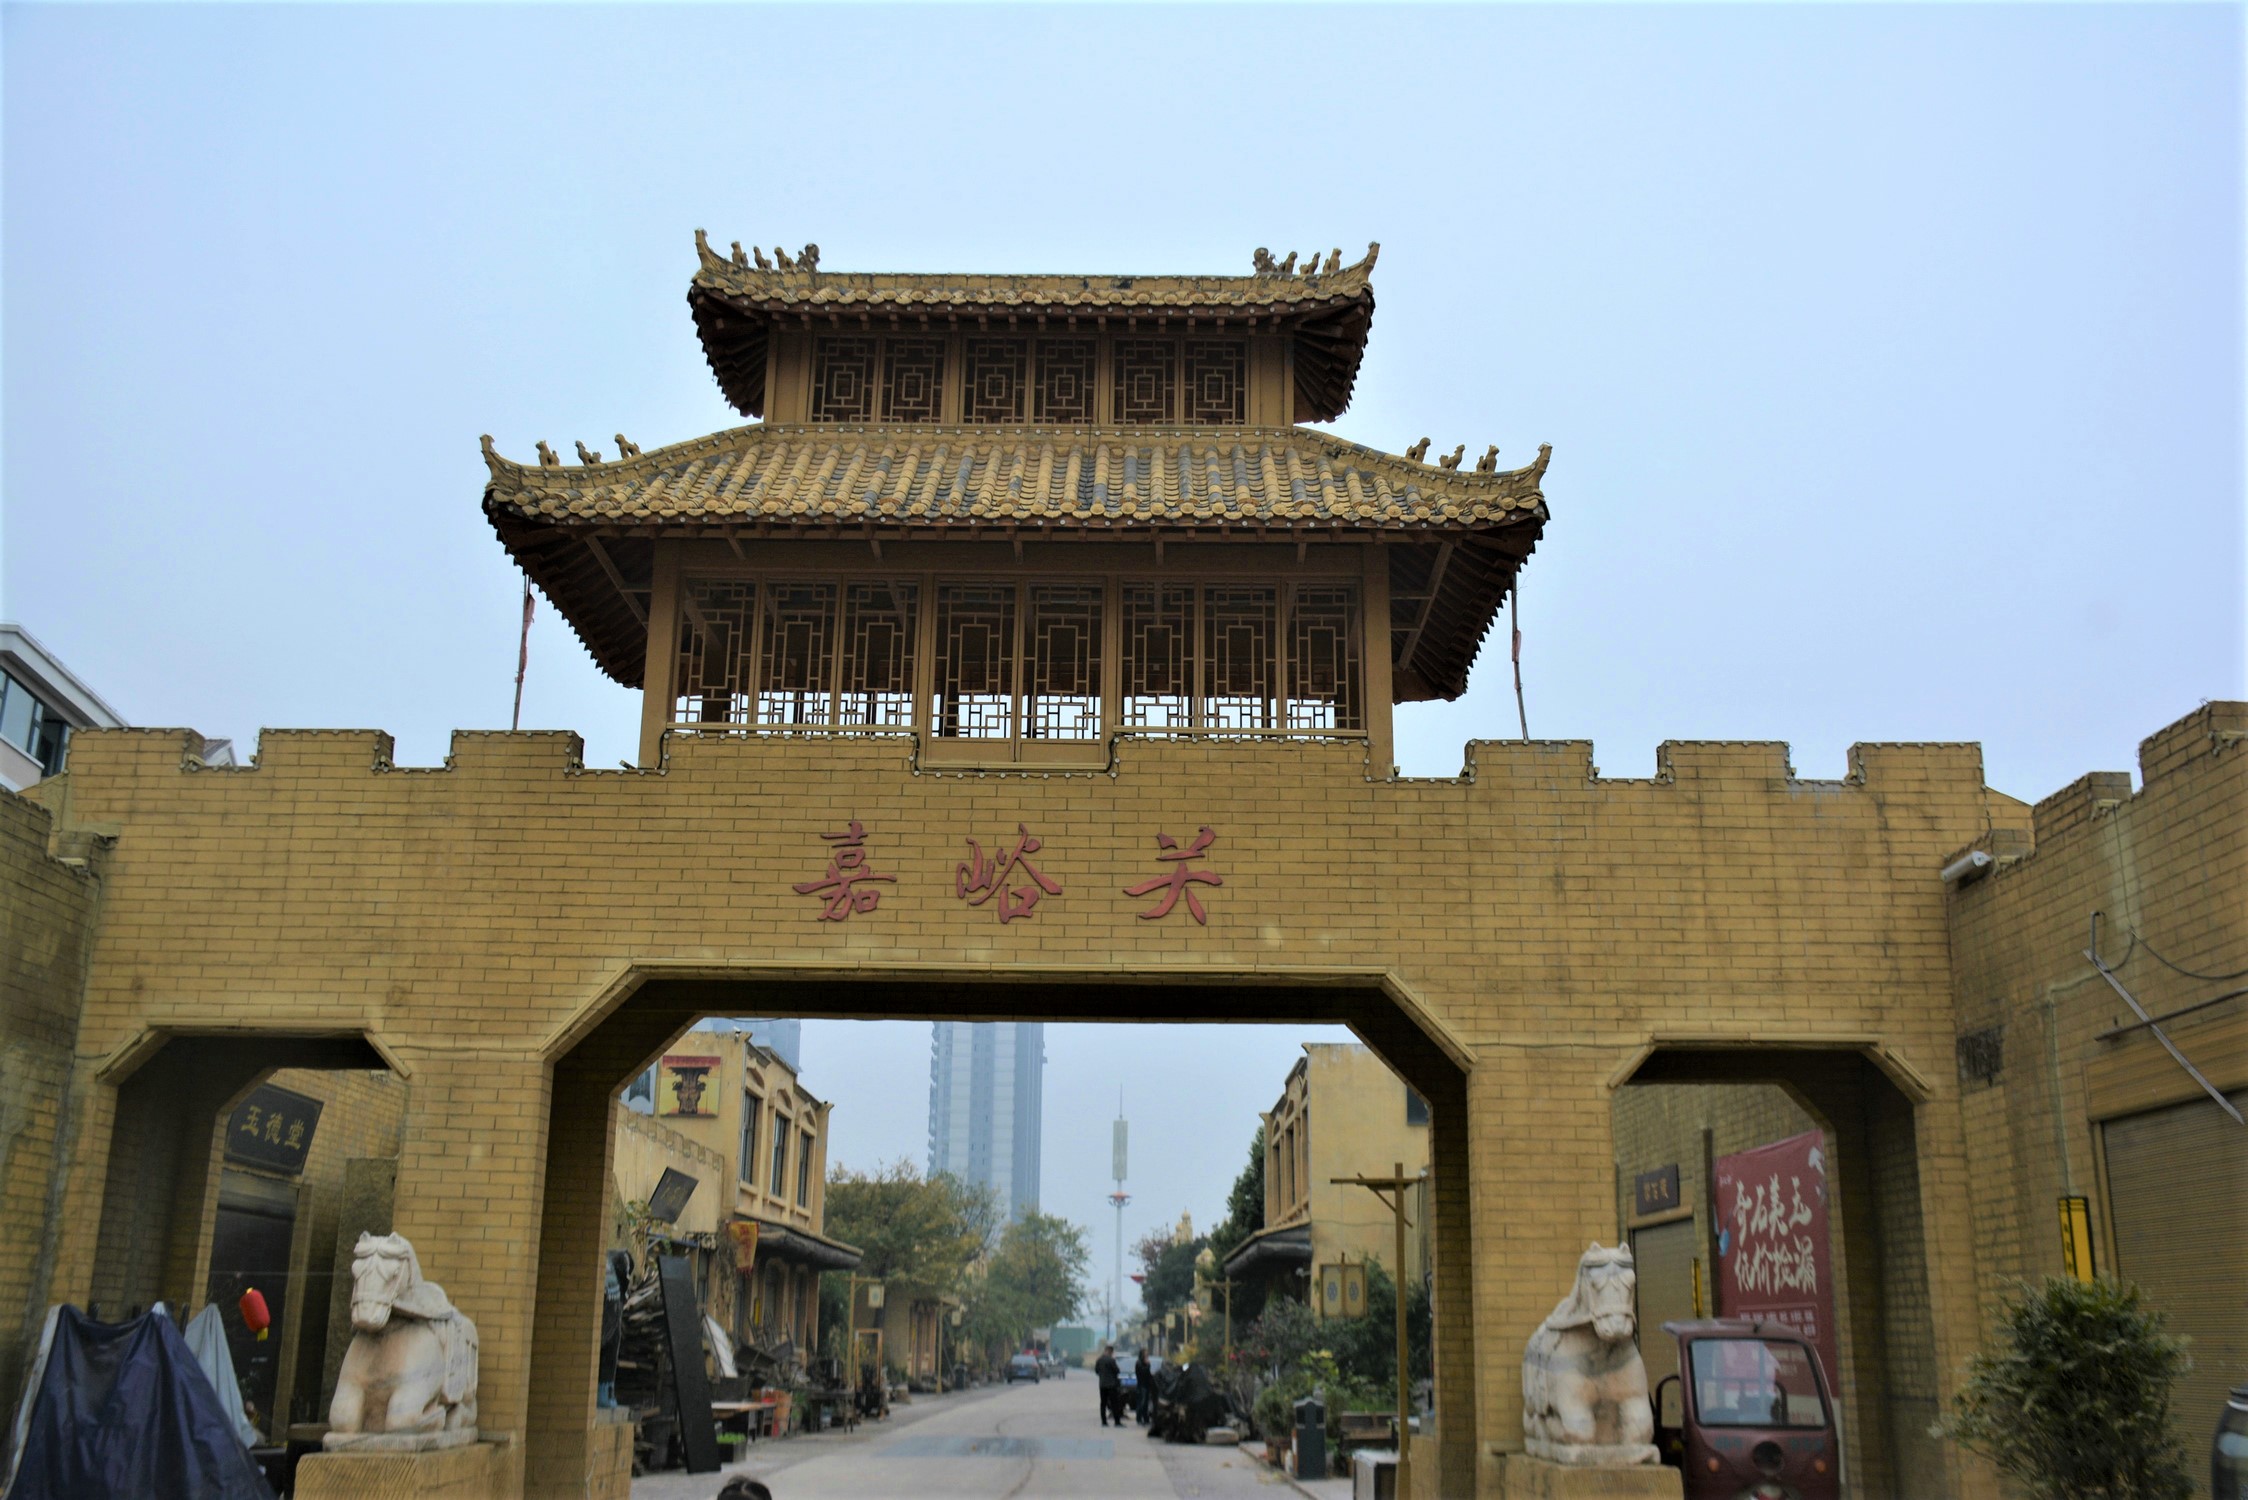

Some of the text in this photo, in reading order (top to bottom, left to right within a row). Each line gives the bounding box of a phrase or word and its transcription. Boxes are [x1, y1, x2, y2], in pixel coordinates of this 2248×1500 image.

[792, 820, 1223, 925] 嘉峪关
[240, 1105, 305, 1150] 玉德堂
[1733, 1172, 1813, 1248] 奇石美玉
